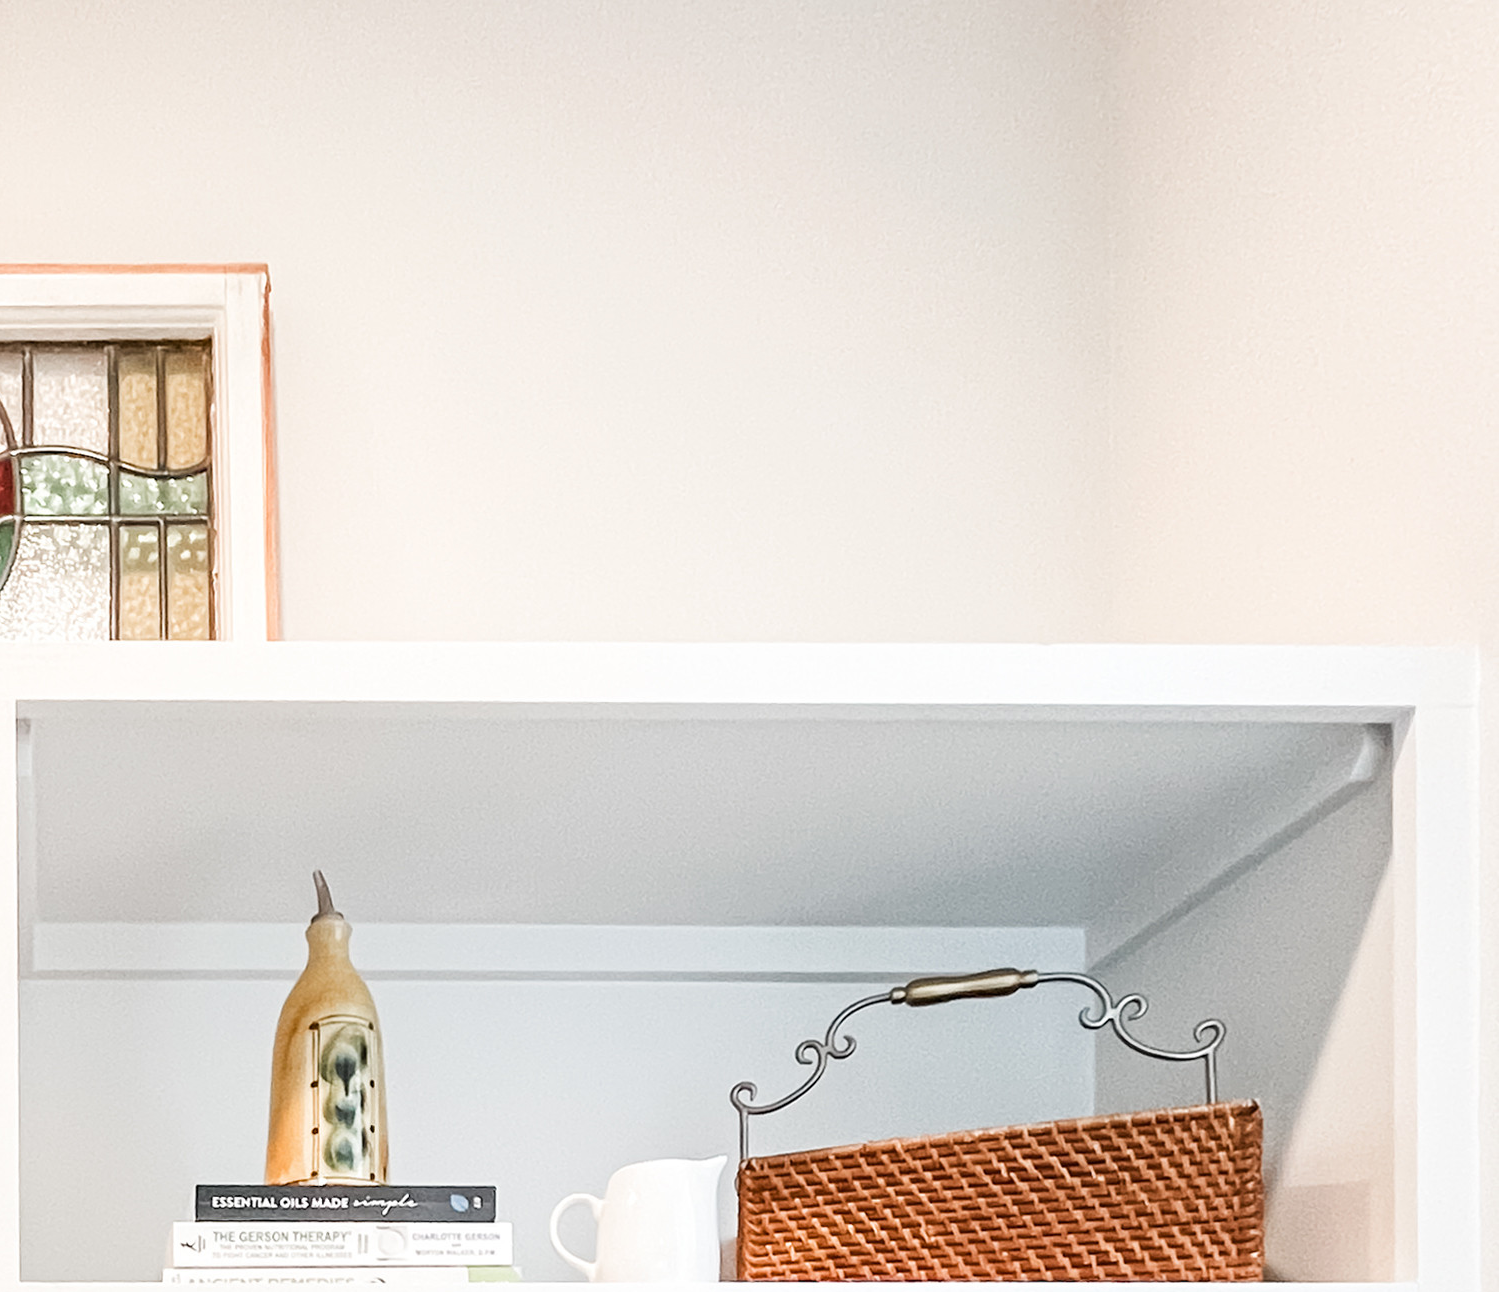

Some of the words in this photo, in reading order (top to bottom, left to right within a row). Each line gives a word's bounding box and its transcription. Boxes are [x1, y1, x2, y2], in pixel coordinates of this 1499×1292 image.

[212, 1196, 278, 1209] ESSENTIAL
[280, 1197, 309, 1209] OILS
[311, 1197, 349, 1209] MADE
[353, 1193, 419, 1216] simple
[213, 1231, 235, 1243] THE
[238, 1231, 289, 1243] GERSON
